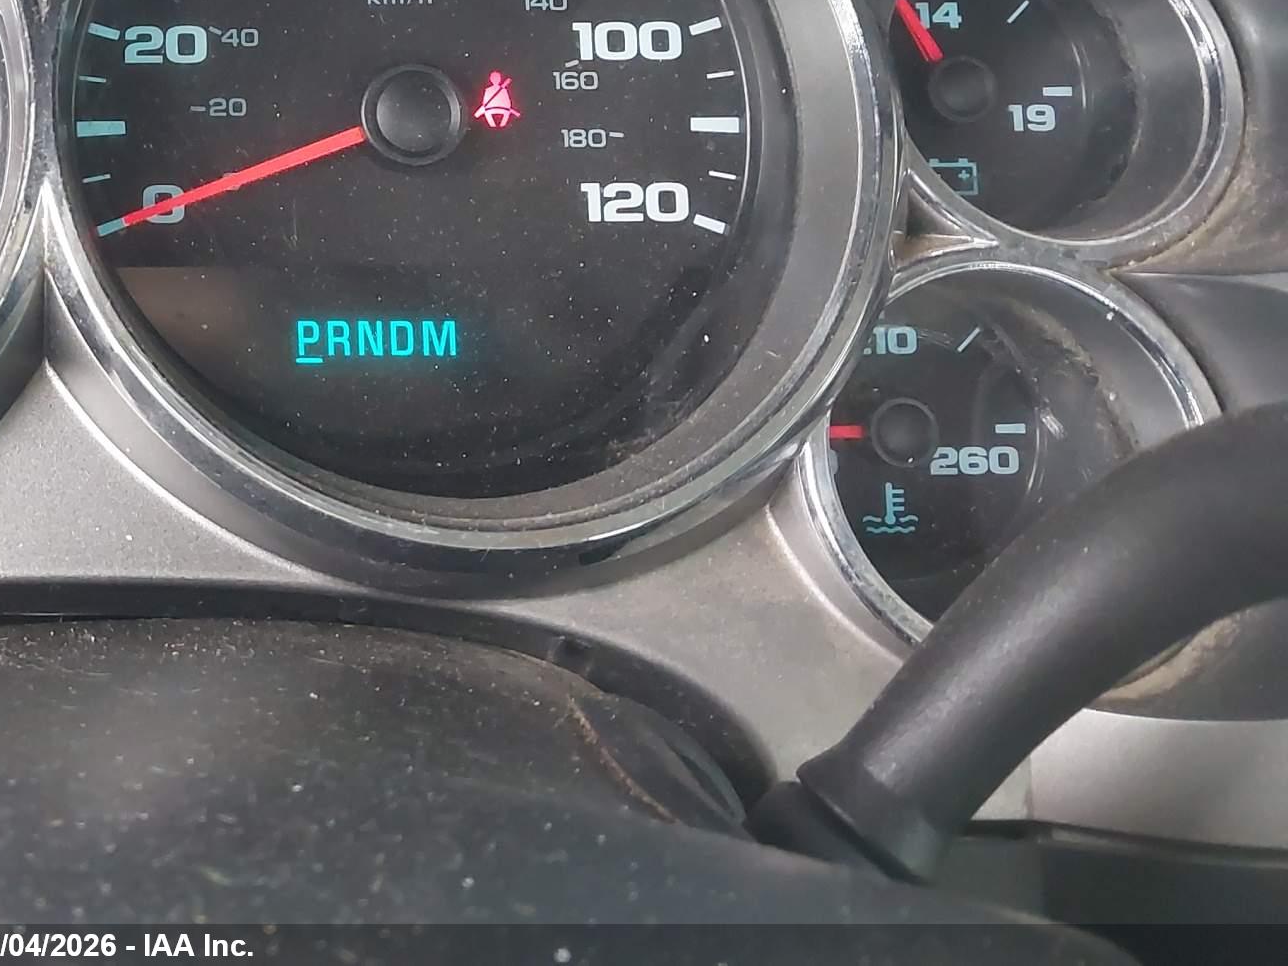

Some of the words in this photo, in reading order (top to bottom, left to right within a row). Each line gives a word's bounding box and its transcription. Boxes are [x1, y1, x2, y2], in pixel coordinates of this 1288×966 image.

[915, 2, 962, 29] 14
[124, 26, 207, 64] 20
[221, 29, 259, 48] 40
[572, 22, 682, 61] 100
[553, 70, 598, 91] 160
[208, 98, 248, 117] 20
[1008, 104, 1056, 132] 19
[561, 129, 607, 148] 180
[142, 185, 185, 225] 0
[580, 183, 689, 222] 120
[864, 326, 918, 355] 10
[930, 446, 1020, 475] 260
